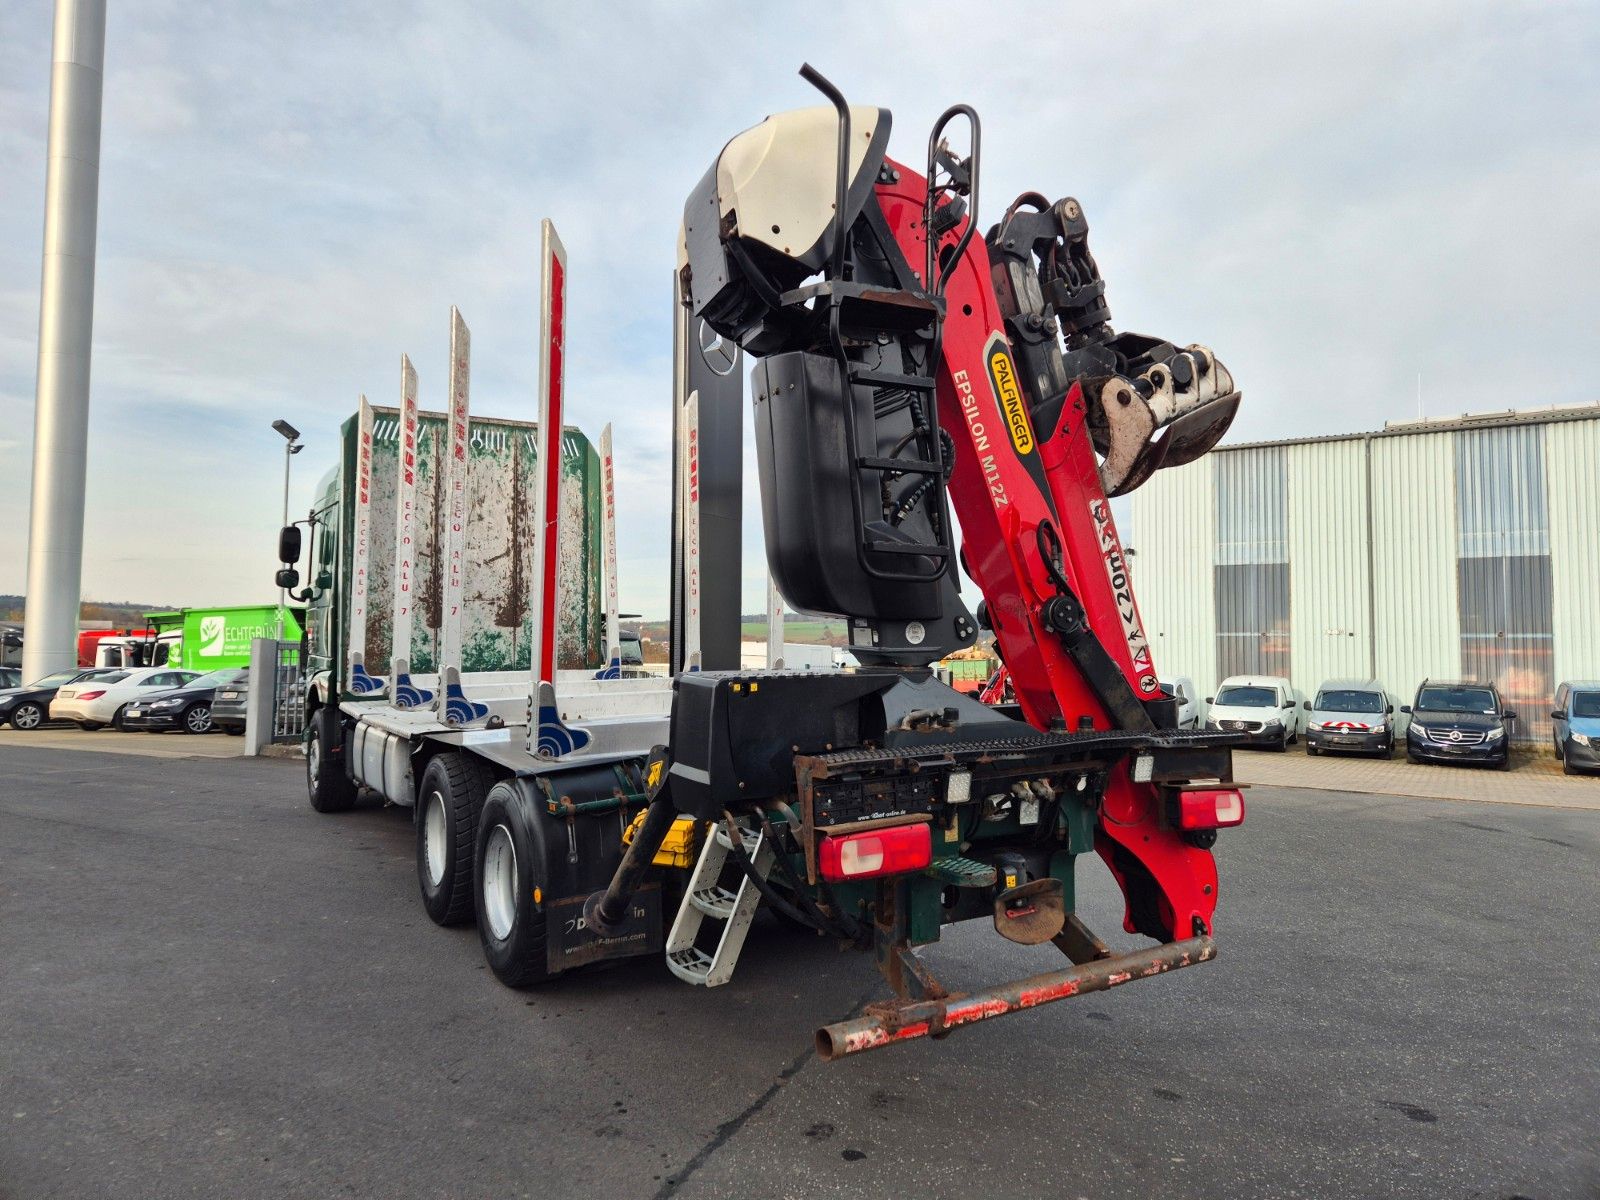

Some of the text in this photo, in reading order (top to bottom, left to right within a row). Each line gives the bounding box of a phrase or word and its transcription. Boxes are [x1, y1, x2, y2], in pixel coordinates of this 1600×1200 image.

[953, 369, 991, 452] EPSILON
[994, 358, 1030, 448] PALFINGER
[401, 560, 409, 592] ALU
